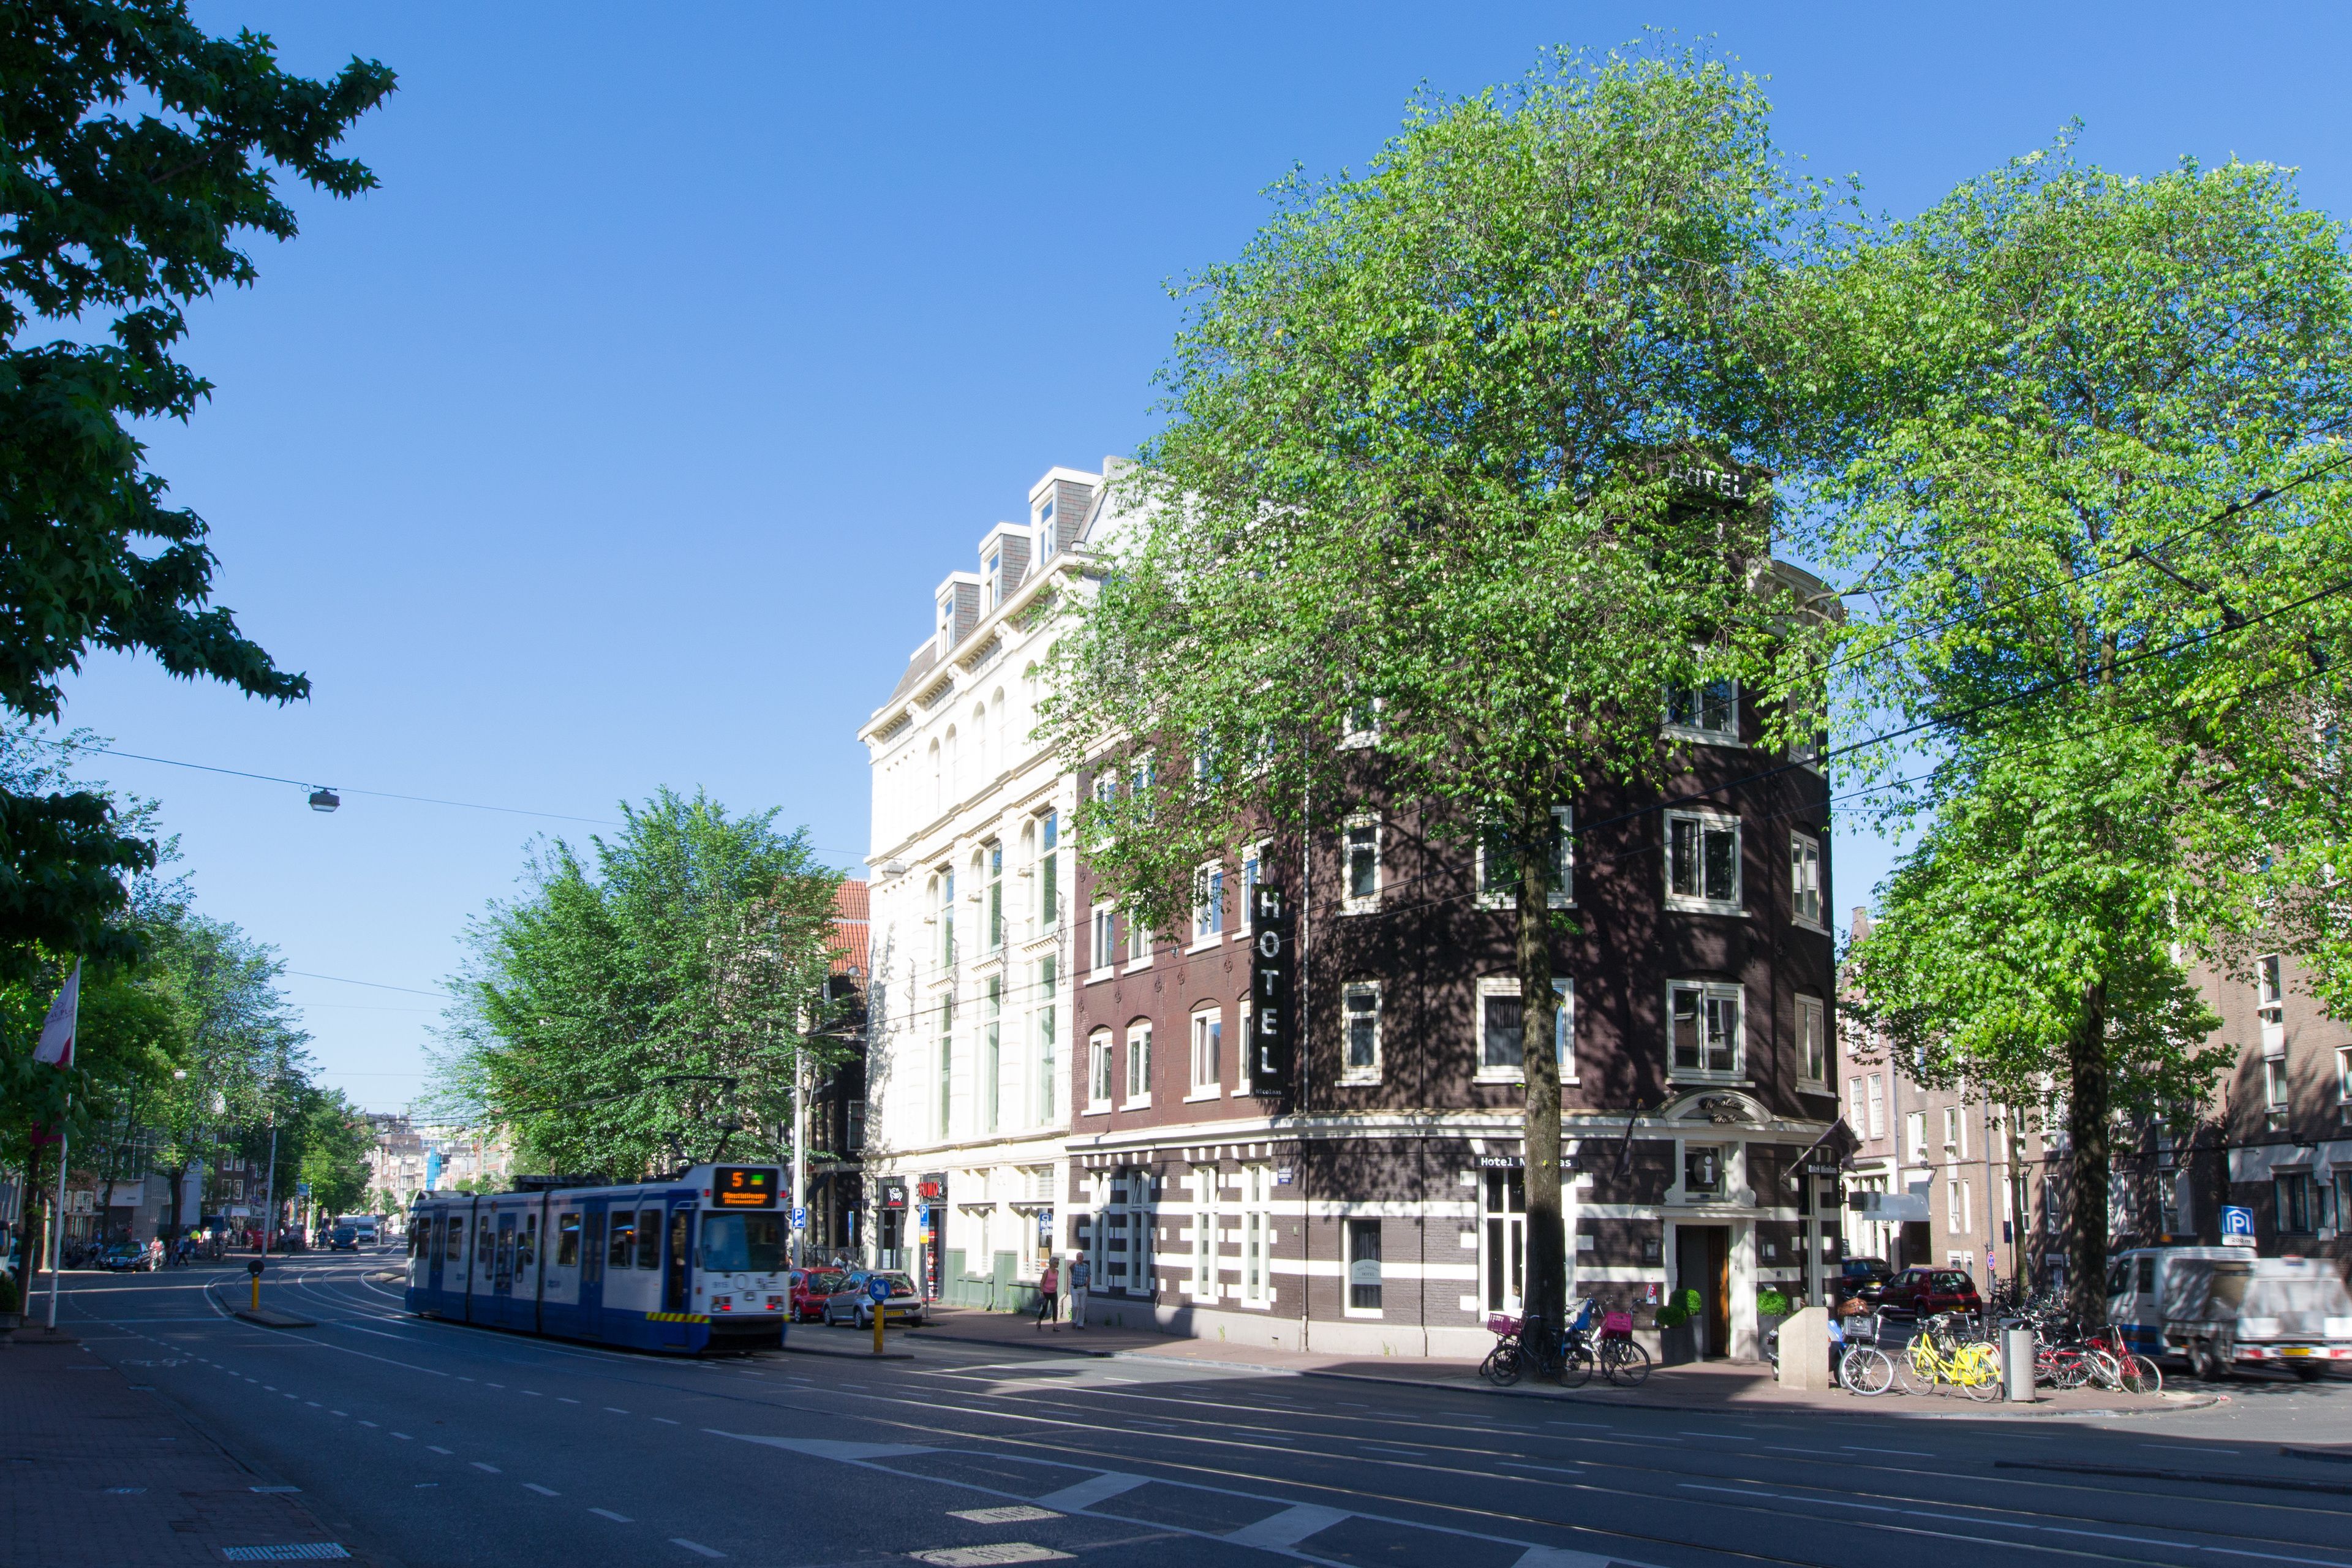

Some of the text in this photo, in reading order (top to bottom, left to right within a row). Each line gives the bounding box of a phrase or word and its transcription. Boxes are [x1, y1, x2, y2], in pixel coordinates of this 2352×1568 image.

[1260, 891, 1280, 1073] HOTEL
[1480, 1157, 1513, 1166] Hotel
[733, 1172, 744, 1187] 5
[919, 1182, 938, 1196] SUMO
[921, 1206, 927, 1218] P
[2232, 1216, 2245, 1232] P
